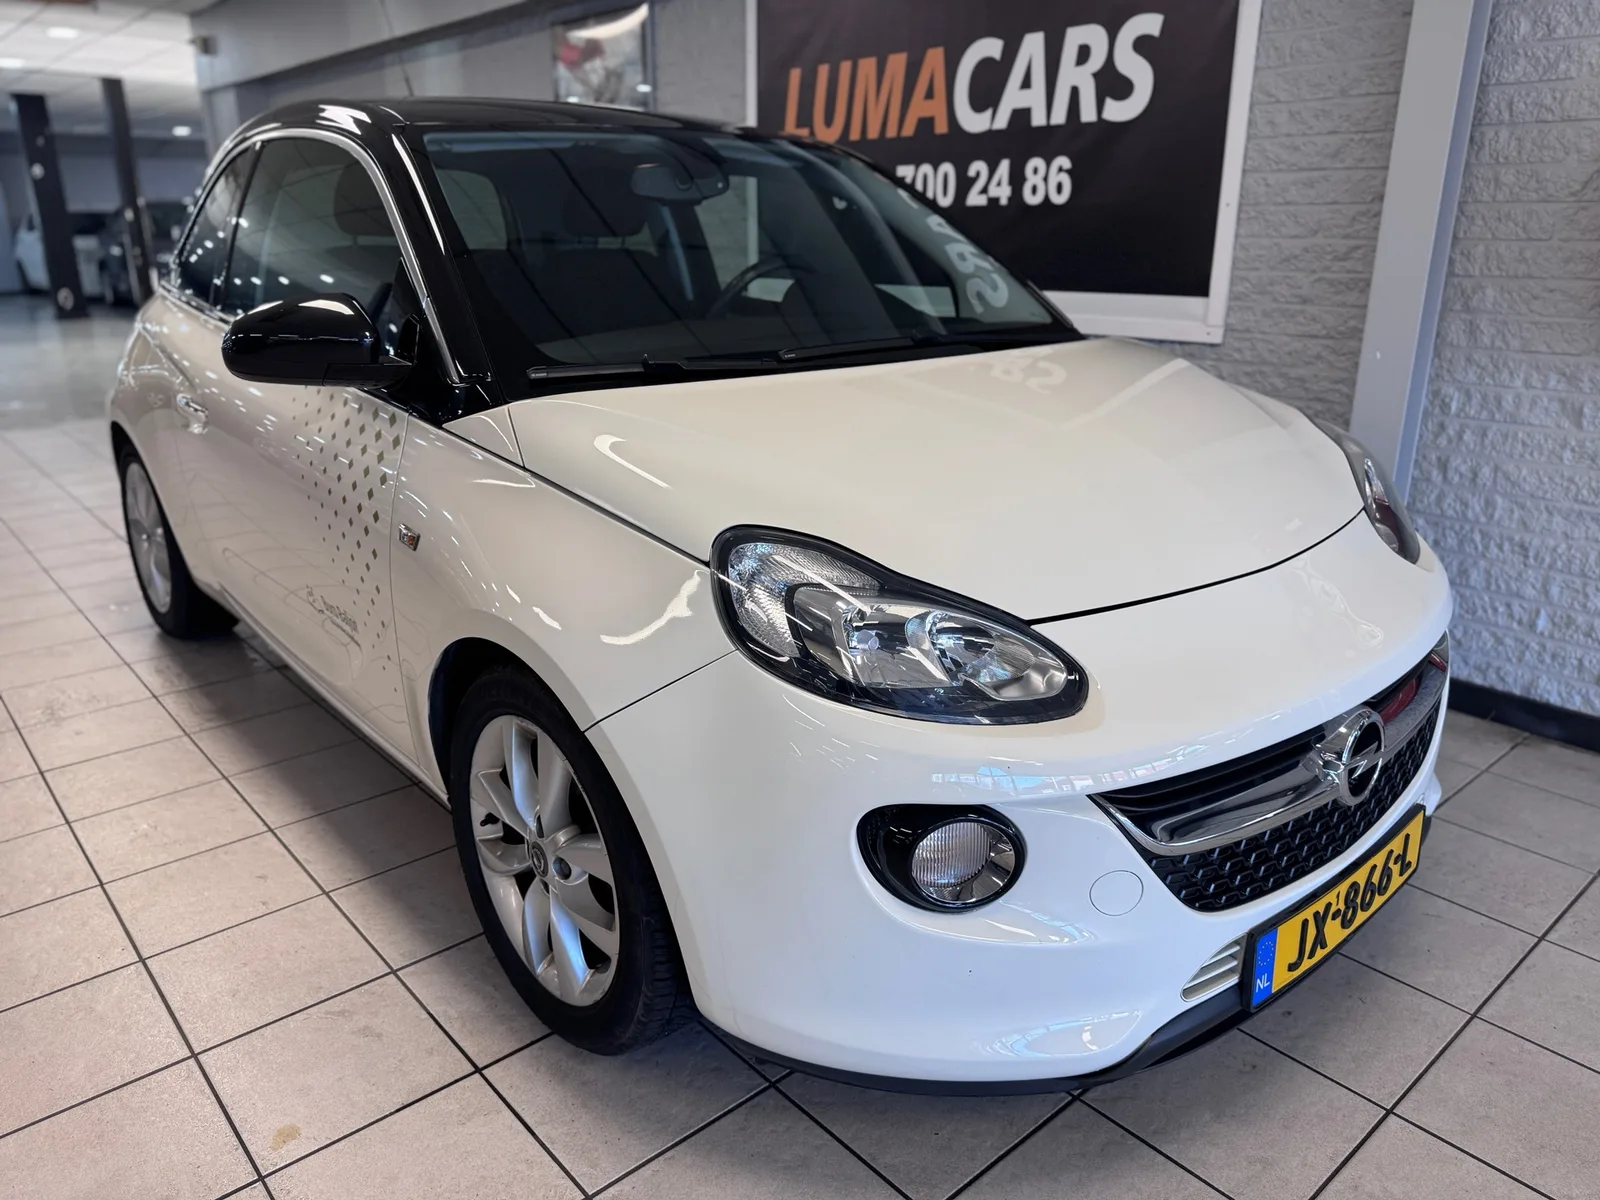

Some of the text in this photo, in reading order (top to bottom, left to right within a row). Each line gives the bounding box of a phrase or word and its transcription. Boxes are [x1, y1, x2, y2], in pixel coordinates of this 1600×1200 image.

[785, 12, 1165, 143] LUMACARS
[965, 159, 1013, 207] 24
[1022, 156, 1072, 206] 86
[1287, 833, 1412, 973] JX-866-L
[1255, 973, 1270, 993] NL
